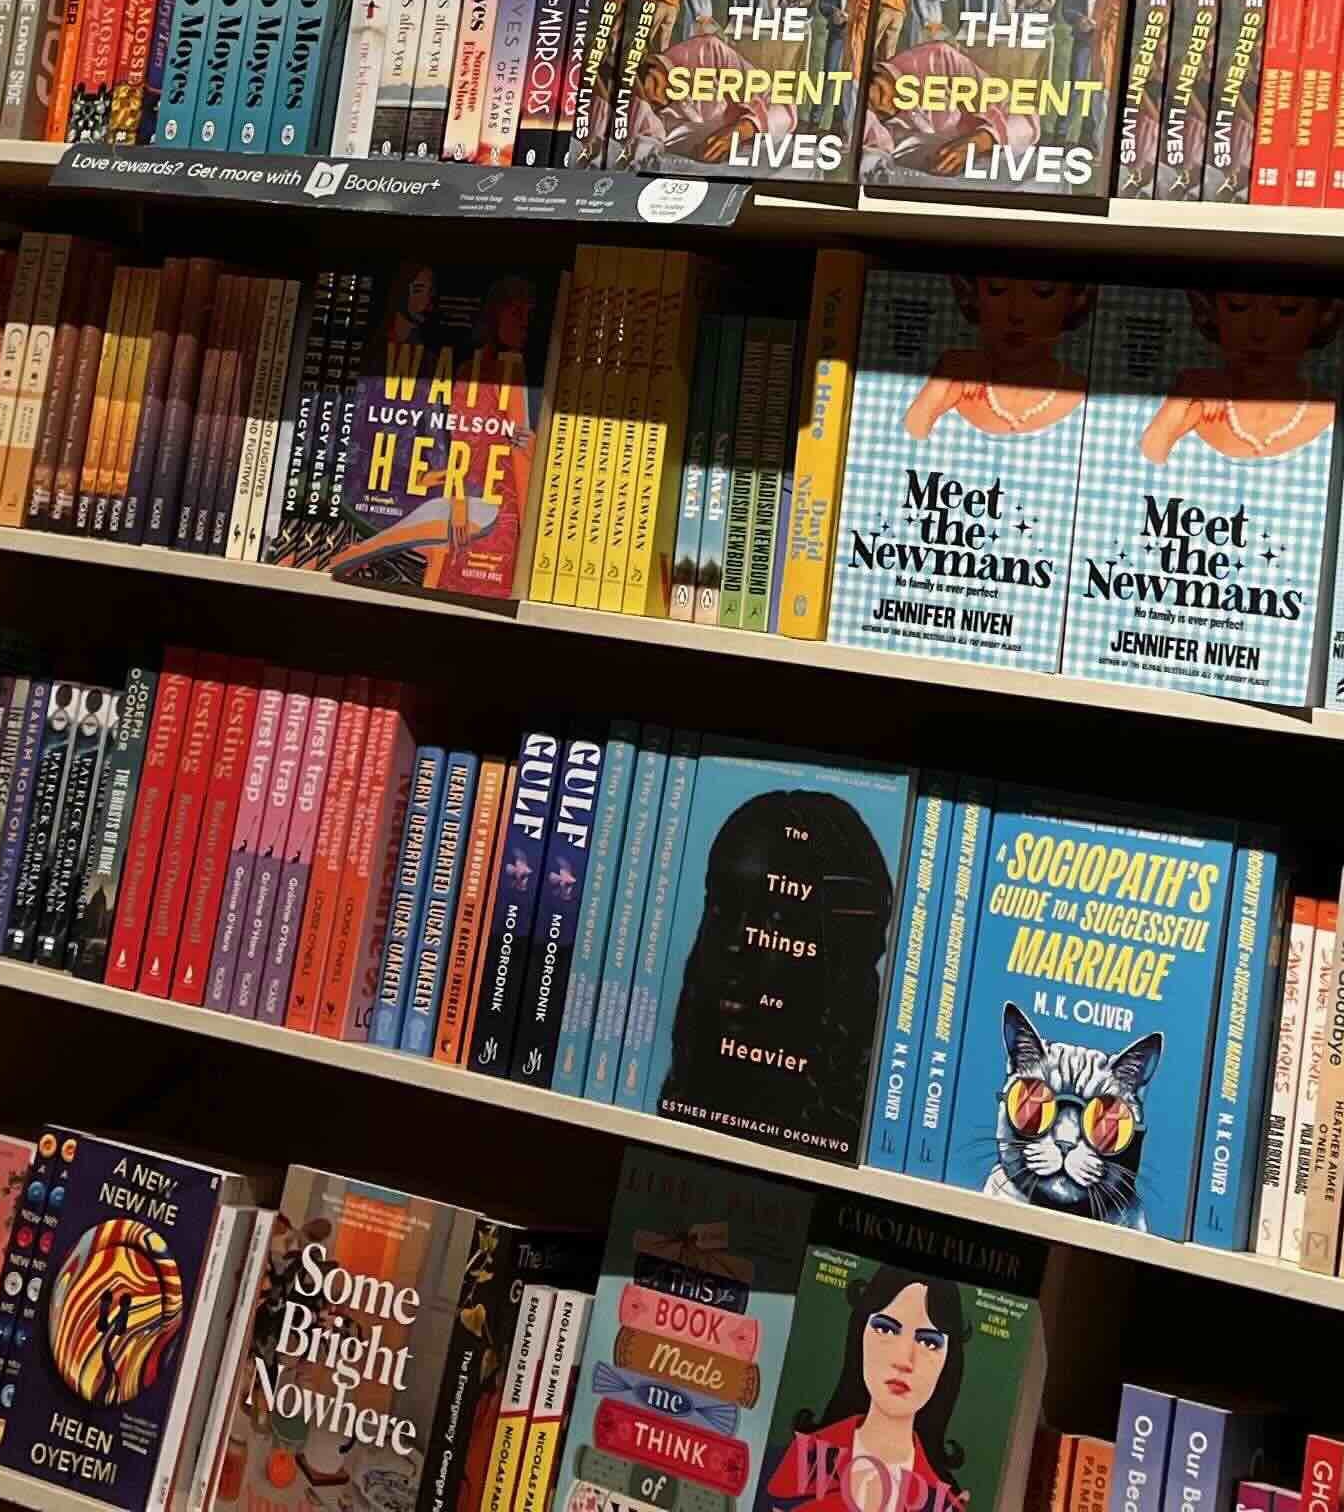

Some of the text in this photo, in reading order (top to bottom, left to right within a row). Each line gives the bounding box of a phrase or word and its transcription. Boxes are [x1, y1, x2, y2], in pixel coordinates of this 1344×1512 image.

[960, 12, 1048, 49] THE
[165, 18, 203, 109] Moyes
[893, 76, 1101, 115] SERPENT
[70, 152, 107, 171] Love
[113, 156, 183, 176] rewards?
[188, 162, 217, 180] Get
[222, 168, 264, 183] more
[268, 167, 301, 187] with
[965, 145, 1092, 183] LIVES
[368, 406, 515, 437] LUCY NELSON
[367, 432, 513, 505] HERE
[1140, 496, 1248, 548] Meet
[1160, 536, 1228, 580] the
[1083, 558, 1303, 620] Newmans
[1210, 619, 1244, 631] perfect
[1110, 631, 1260, 670] JENNIFER NIVEN
[511, 732, 559, 841] GULF
[784, 826, 809, 841] The
[766, 873, 813, 901] Tiny
[1007, 833, 1219, 912] SOCIOPATH'S
[989, 883, 1051, 922] GUIDE
[1080, 901, 1210, 952] SUCCESSFUL
[745, 926, 817, 958] Things
[1007, 926, 1176, 1001] MARRIAGE
[759, 994, 784, 1008] Are
[720, 1037, 807, 1073] Heavier
[661, 1099, 707, 1118] ESTHER
[783, 1129, 849, 1152] OKONKWO
[132, 1163, 177, 1194] NEW
[98, 1184, 177, 1227] NEW ME
[294, 1243, 420, 1326] Some
[670, 1269, 714, 1304] THIS
[653, 1300, 723, 1344] BOOK
[278, 1311, 411, 1390] Bright
[650, 1344, 727, 1390] Made
[245, 1357, 416, 1455] Nowhere
[647, 1383, 684, 1415] me
[50, 1413, 113, 1455] HELEN
[633, 1422, 707, 1469] THINK
[30, 1443, 117, 1485] OYEYEMI
[640, 1476, 666, 1501] of
